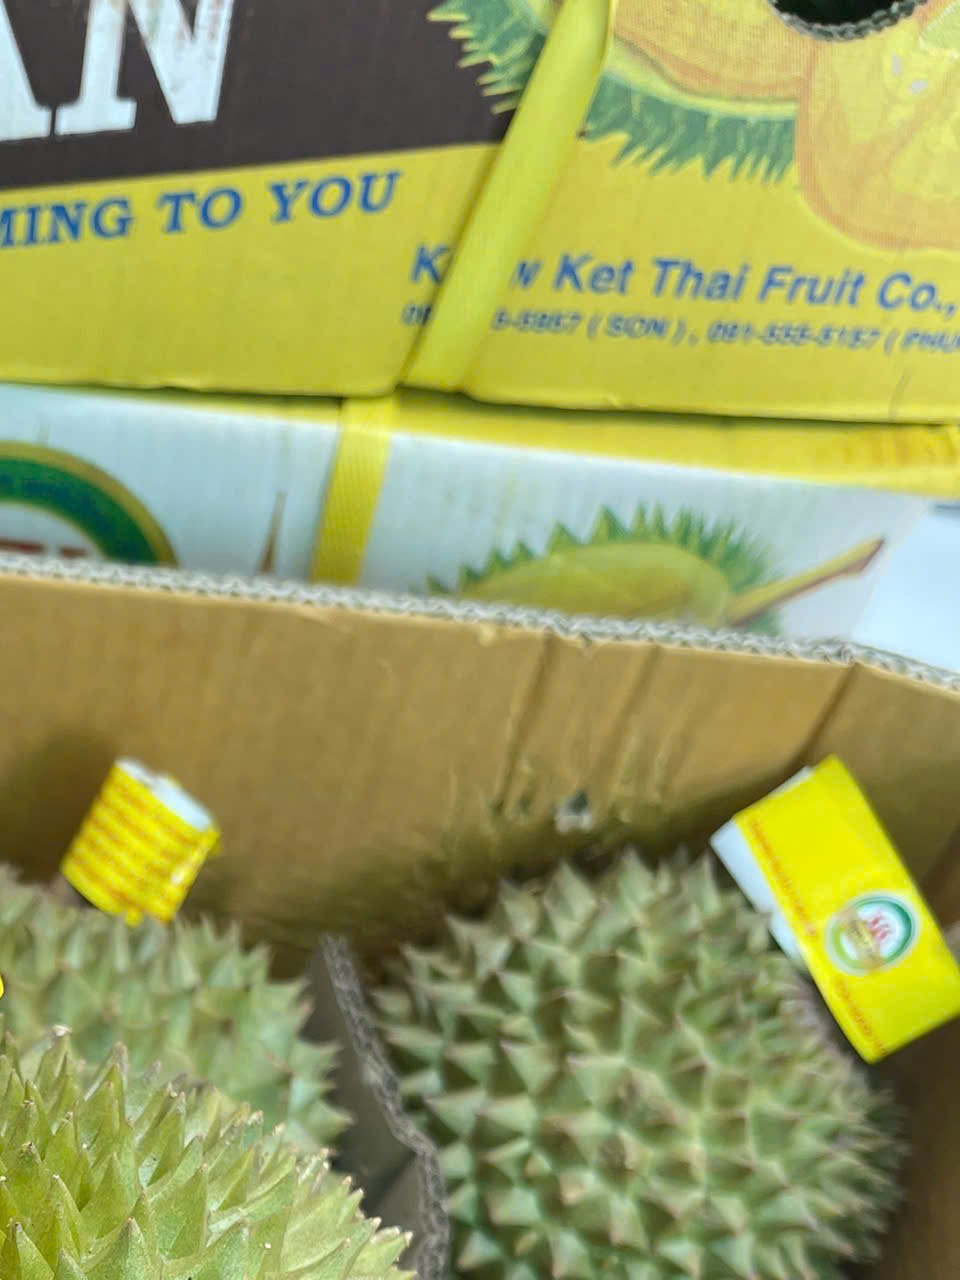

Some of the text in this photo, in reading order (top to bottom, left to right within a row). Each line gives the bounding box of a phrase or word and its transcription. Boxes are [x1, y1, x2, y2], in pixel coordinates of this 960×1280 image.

[157, 187, 244, 235] TO
[268, 170, 401, 223] YOU
[554, 252, 635, 294] Ket
[652, 256, 750, 301] Thai
[759, 265, 865, 306] Fruit
